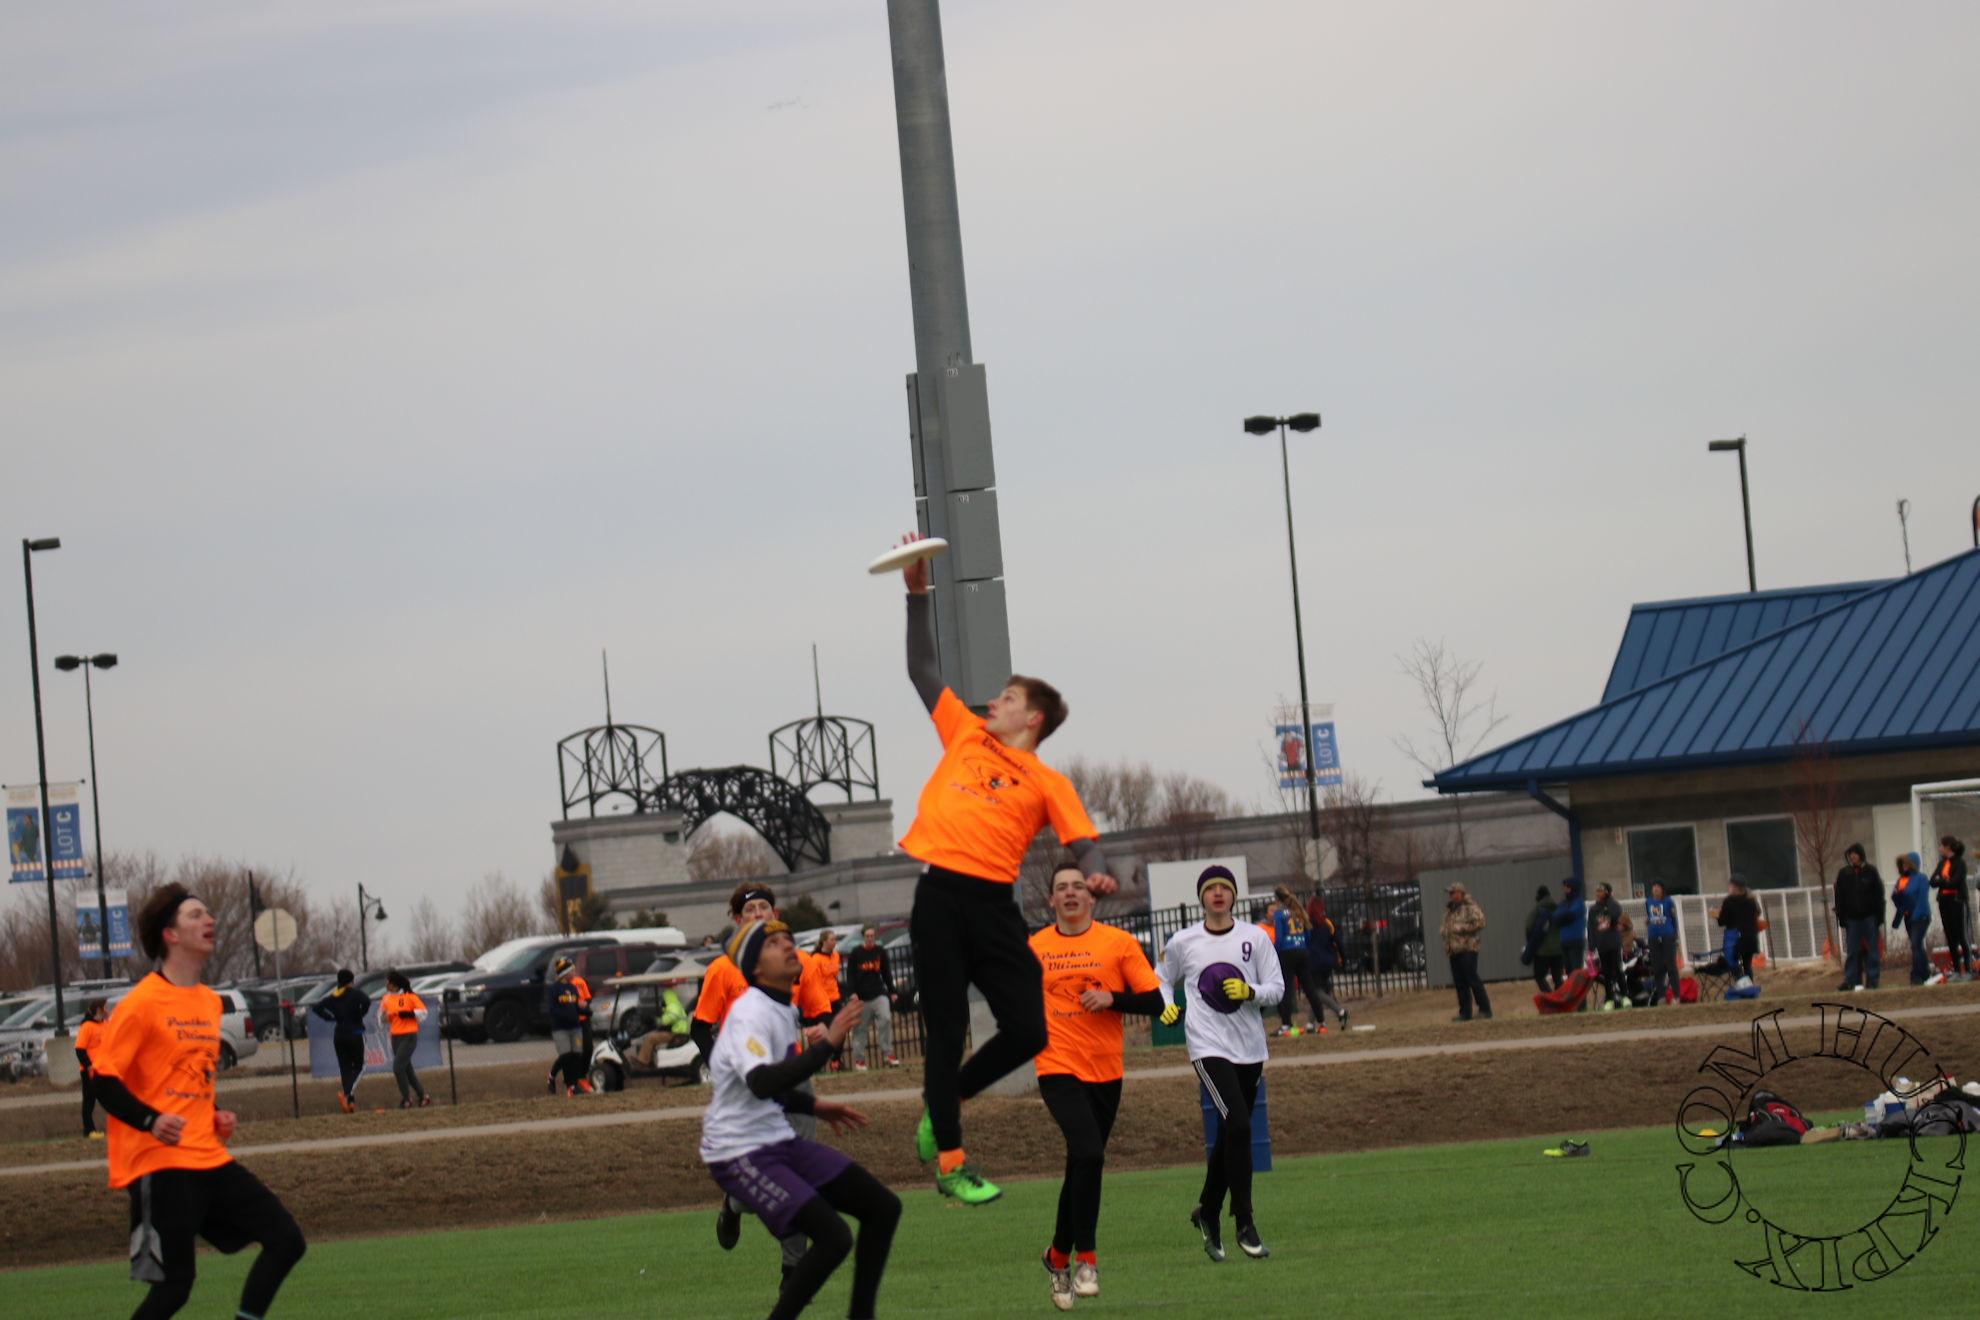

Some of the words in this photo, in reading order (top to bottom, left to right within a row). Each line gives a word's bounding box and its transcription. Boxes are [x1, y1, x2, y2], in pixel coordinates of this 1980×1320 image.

[1317, 728, 1330, 739] C
[1319, 740, 1334, 765] LOT
[56, 810, 72, 824] C
[56, 826, 74, 855] LOT
[1241, 941, 1253, 962] 9
